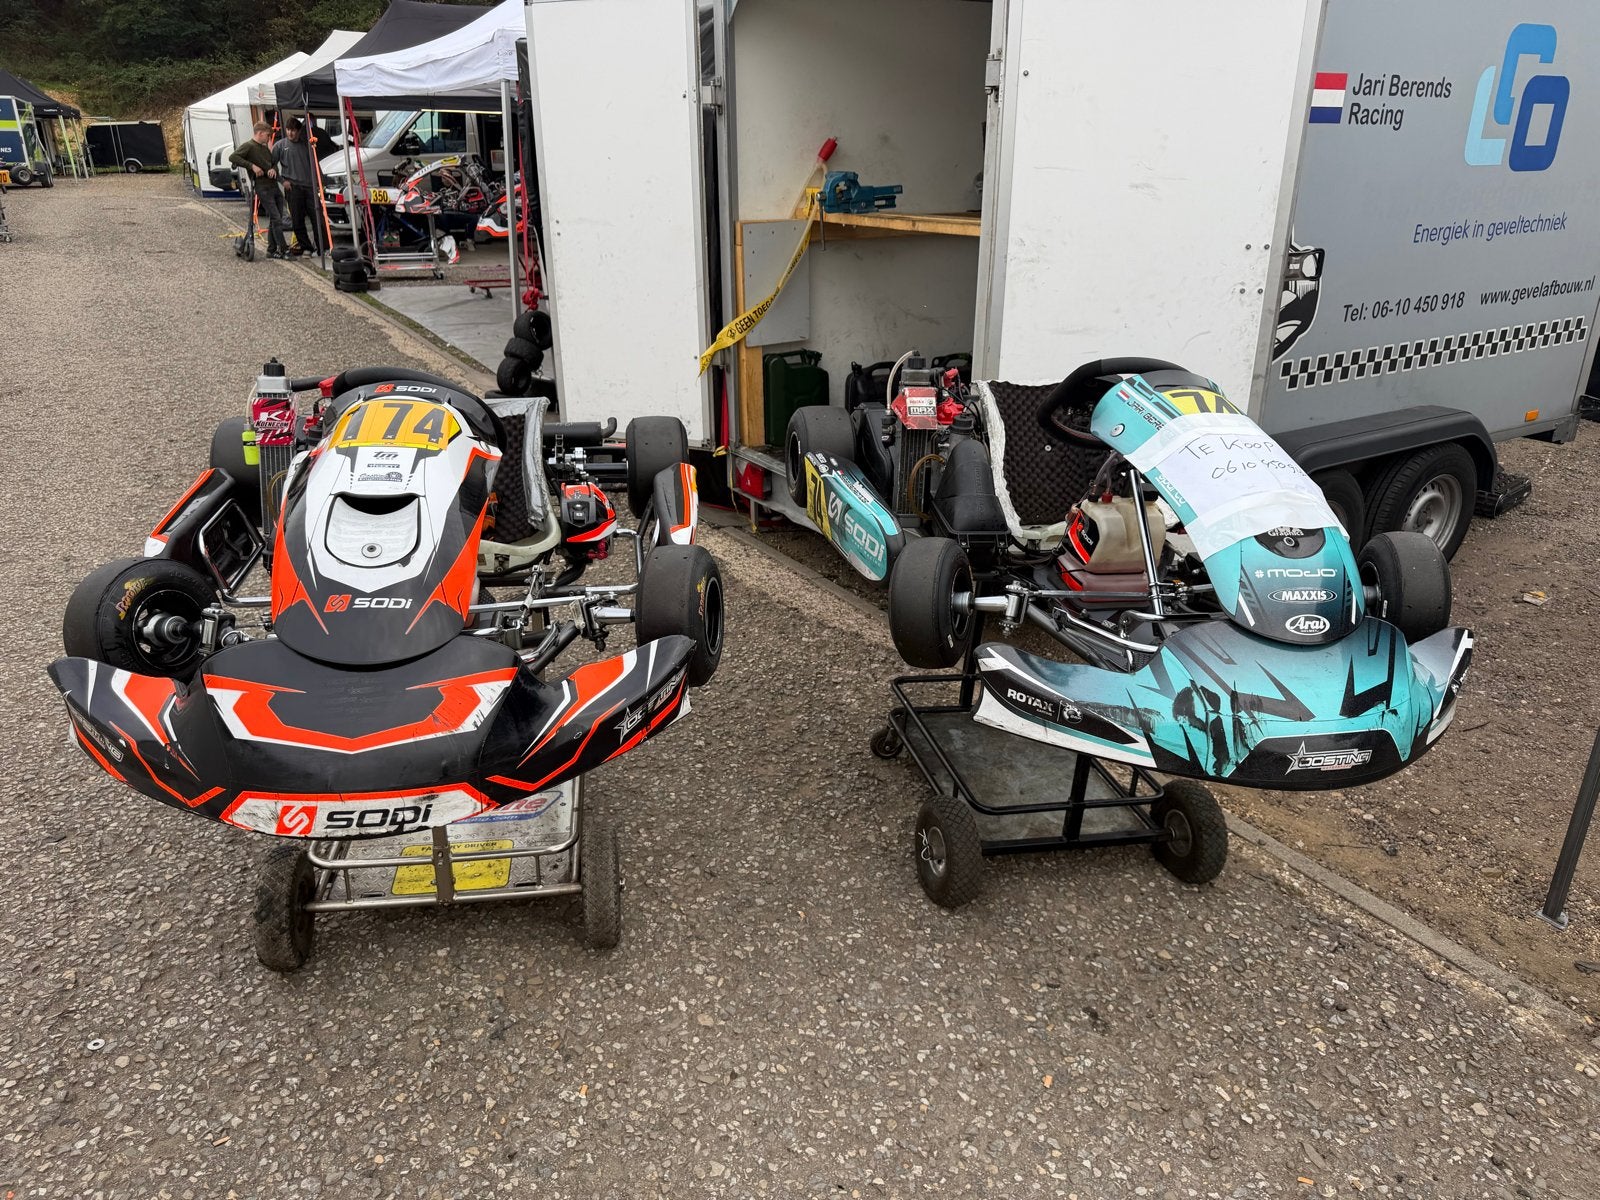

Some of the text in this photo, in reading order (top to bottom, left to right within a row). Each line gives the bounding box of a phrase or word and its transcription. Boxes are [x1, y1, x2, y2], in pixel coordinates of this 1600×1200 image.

[1352, 73, 1453, 98] Jari Berends
[1348, 102, 1404, 131] Racing
[372, 188, 389, 202] 350
[1413, 211, 1568, 246] Energiek in geveltechniek
[1480, 275, 1596, 305] www.gevelafbouw.nl
[1343, 291, 1465, 322] Tel: 06-10 450 918
[735, 314, 756, 334] GEEN
[342, 402, 446, 444] 174
[1179, 437, 1215, 460] TE
[1281, 590, 1327, 601] MAXXIS
[1289, 616, 1326, 631] Arai
